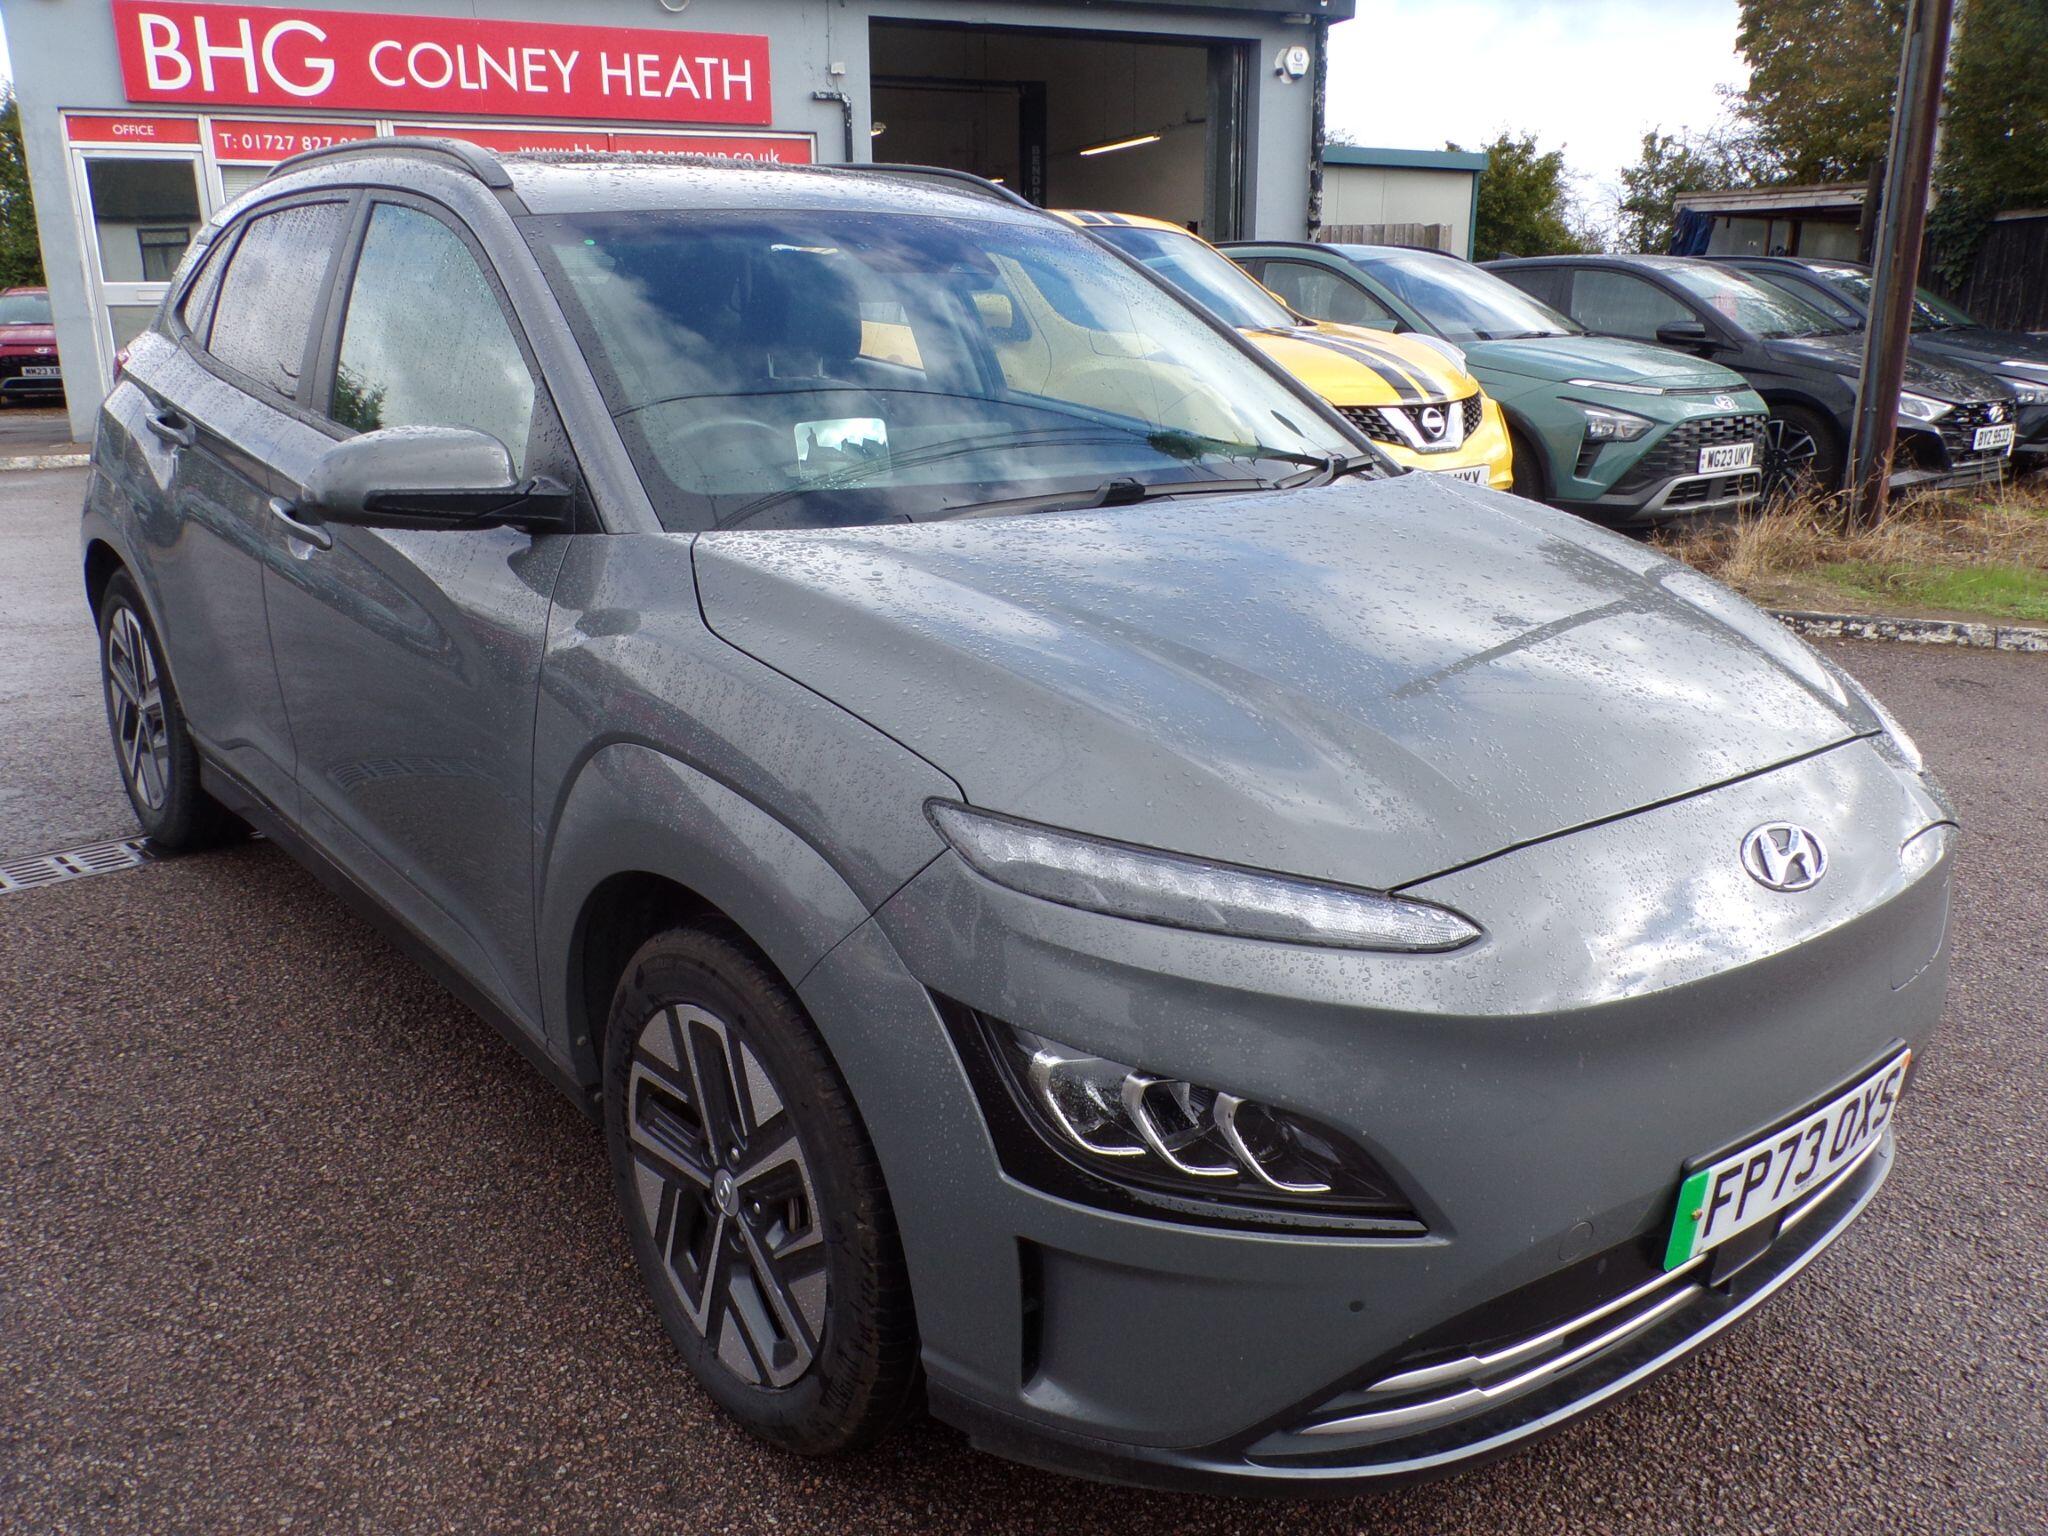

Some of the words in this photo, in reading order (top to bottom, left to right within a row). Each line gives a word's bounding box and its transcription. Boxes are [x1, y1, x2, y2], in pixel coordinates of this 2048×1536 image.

[138, 12, 335, 97] BHG
[368, 40, 580, 93] COLNEY
[600, 51, 753, 102] HEATH
[112, 124, 155, 136] OFFICE
[219, 133, 238, 149] T:
[242, 134, 294, 150] 01727
[302, 136, 332, 151] 827
[1707, 448, 1733, 469] WG23
[1702, 1117, 1828, 1239] FP73
[1829, 1065, 1902, 1163] OXS
